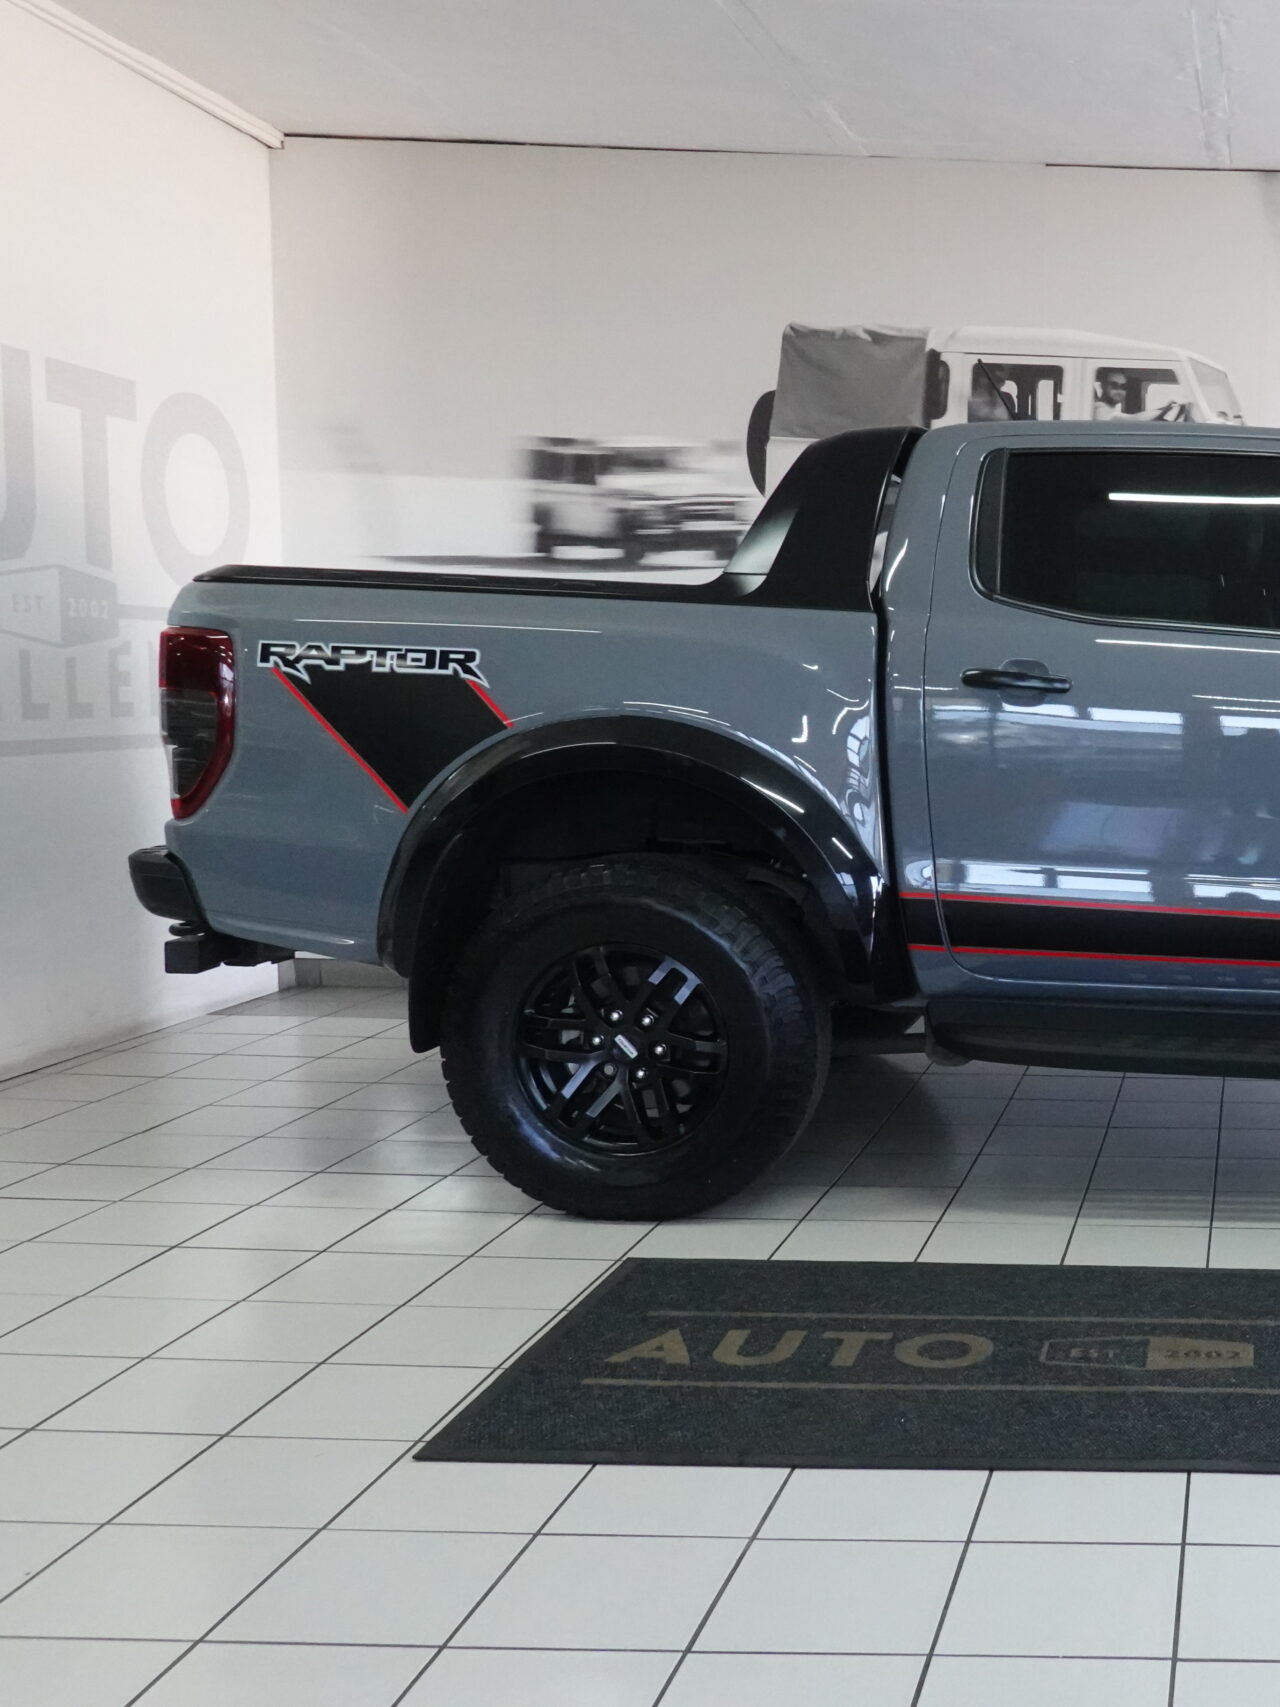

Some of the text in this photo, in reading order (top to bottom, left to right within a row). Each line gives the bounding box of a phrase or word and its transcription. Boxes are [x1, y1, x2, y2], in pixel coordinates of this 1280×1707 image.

[12, 593, 109, 619] EST 2002
[257, 640, 490, 689] RAPTOR
[604, 1328, 994, 1369] AUTO
[1069, 1347, 1121, 1360] EST
[1164, 1348, 1242, 1361] 2002
